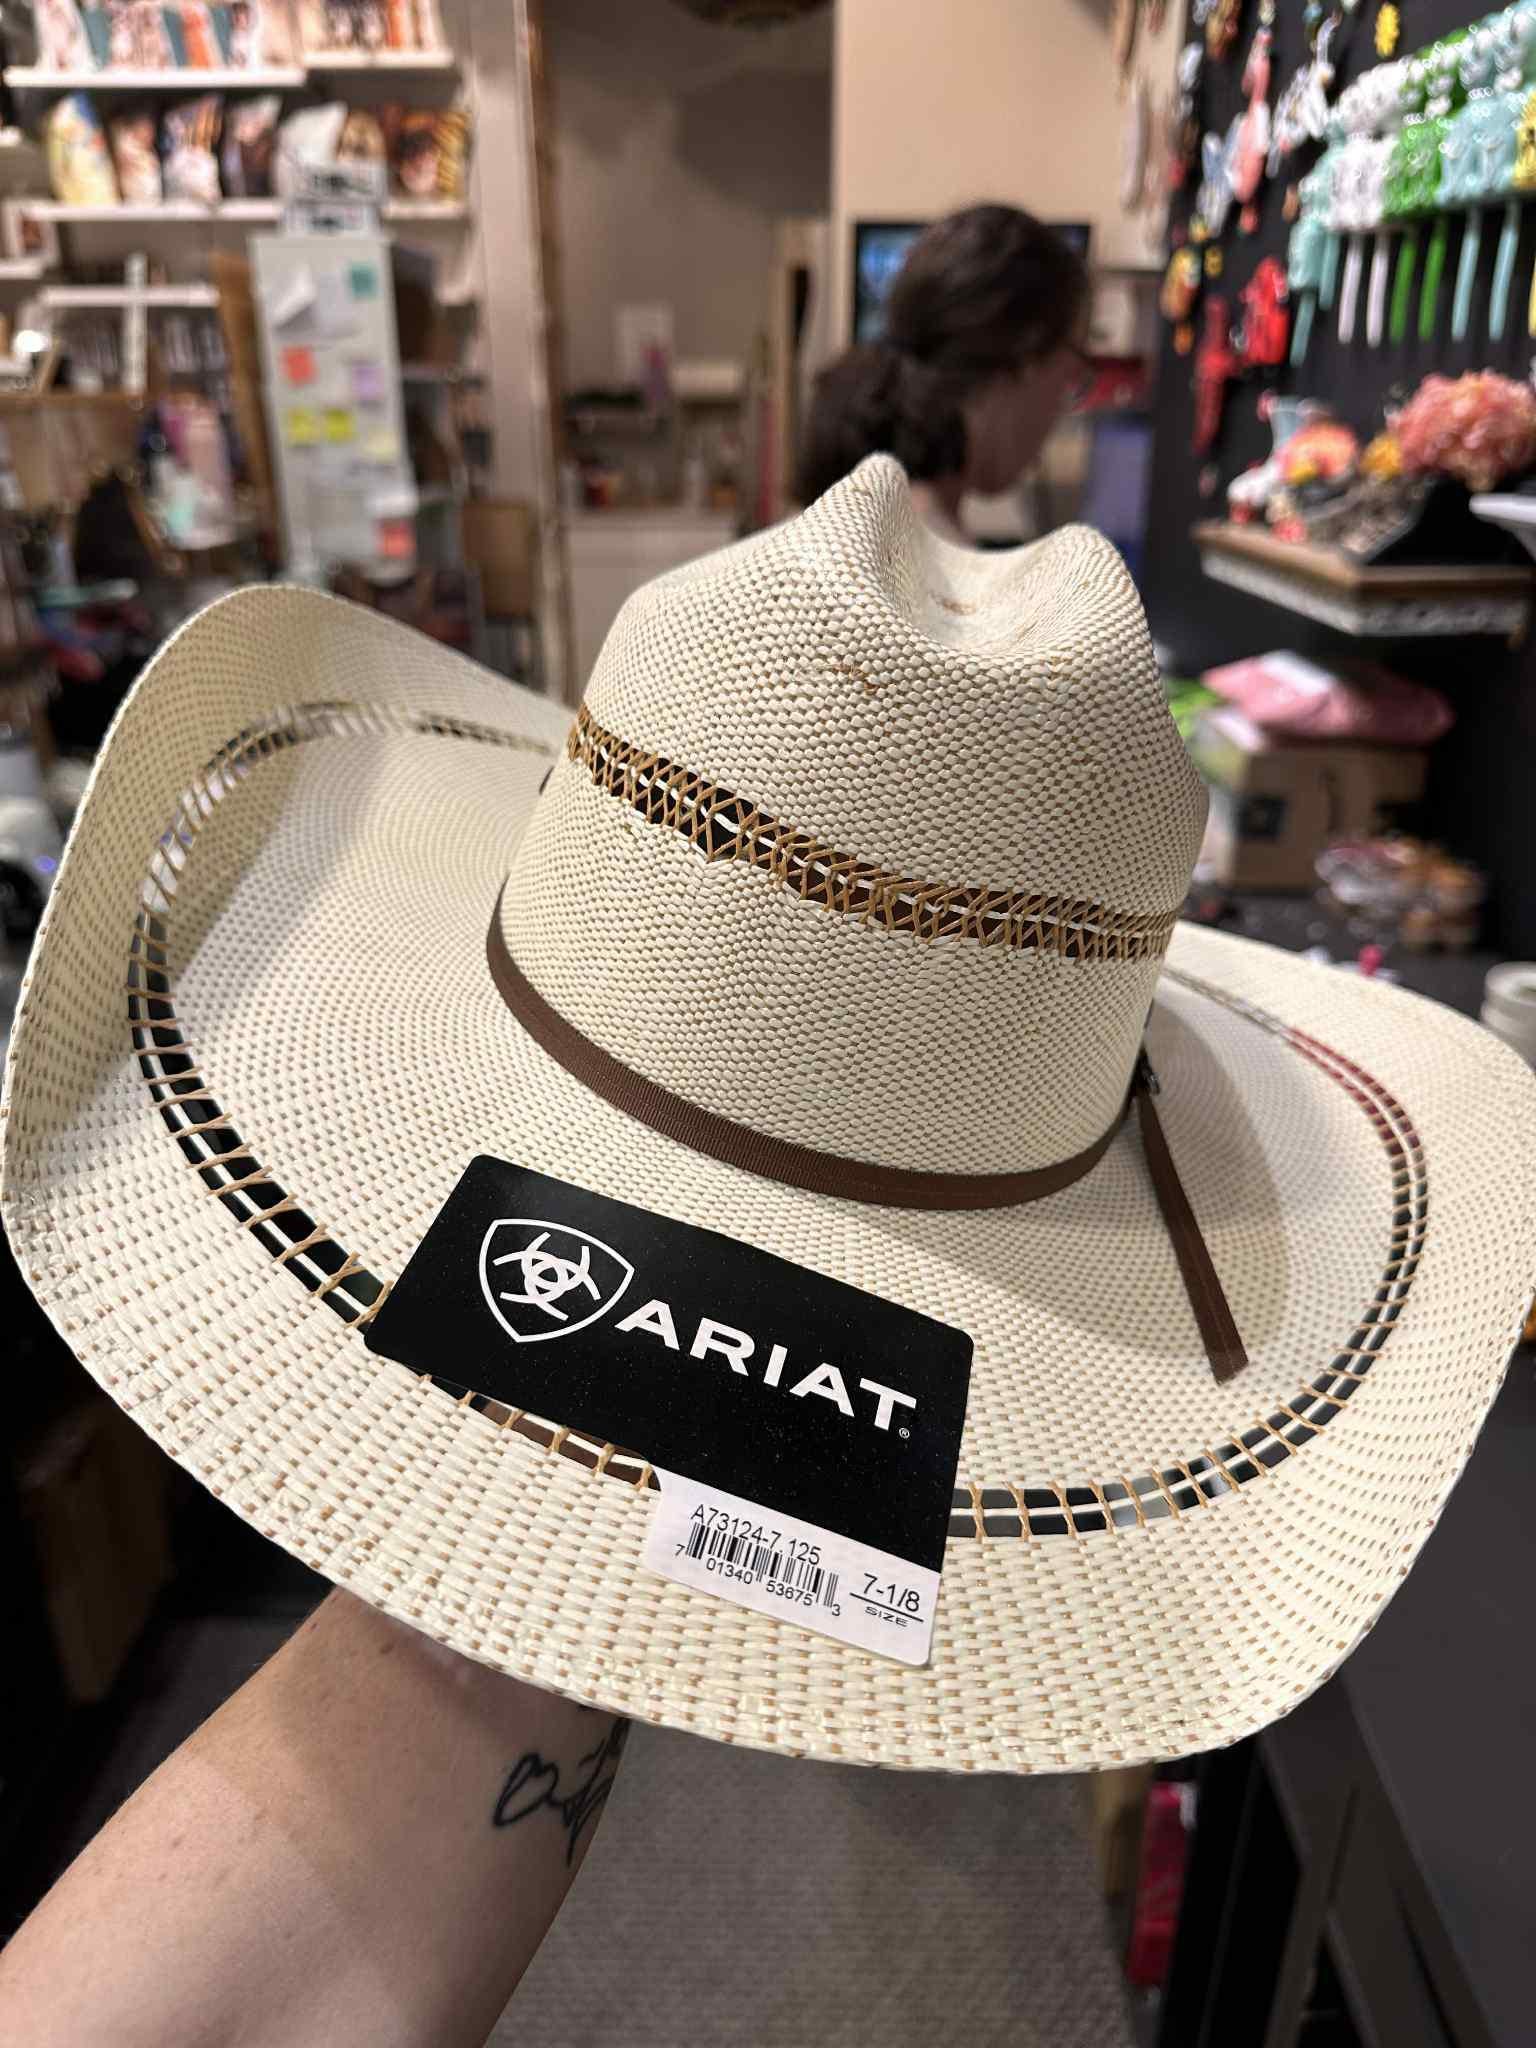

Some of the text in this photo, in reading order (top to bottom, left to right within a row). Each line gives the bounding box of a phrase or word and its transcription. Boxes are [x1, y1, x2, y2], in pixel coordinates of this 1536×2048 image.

[615, 1299, 917, 1431] ARIAT
[675, 1543, 841, 1617] 7 01340 53675 3
[863, 1572, 921, 1613] 7-1/8
[864, 1605, 909, 1628] SIZE
